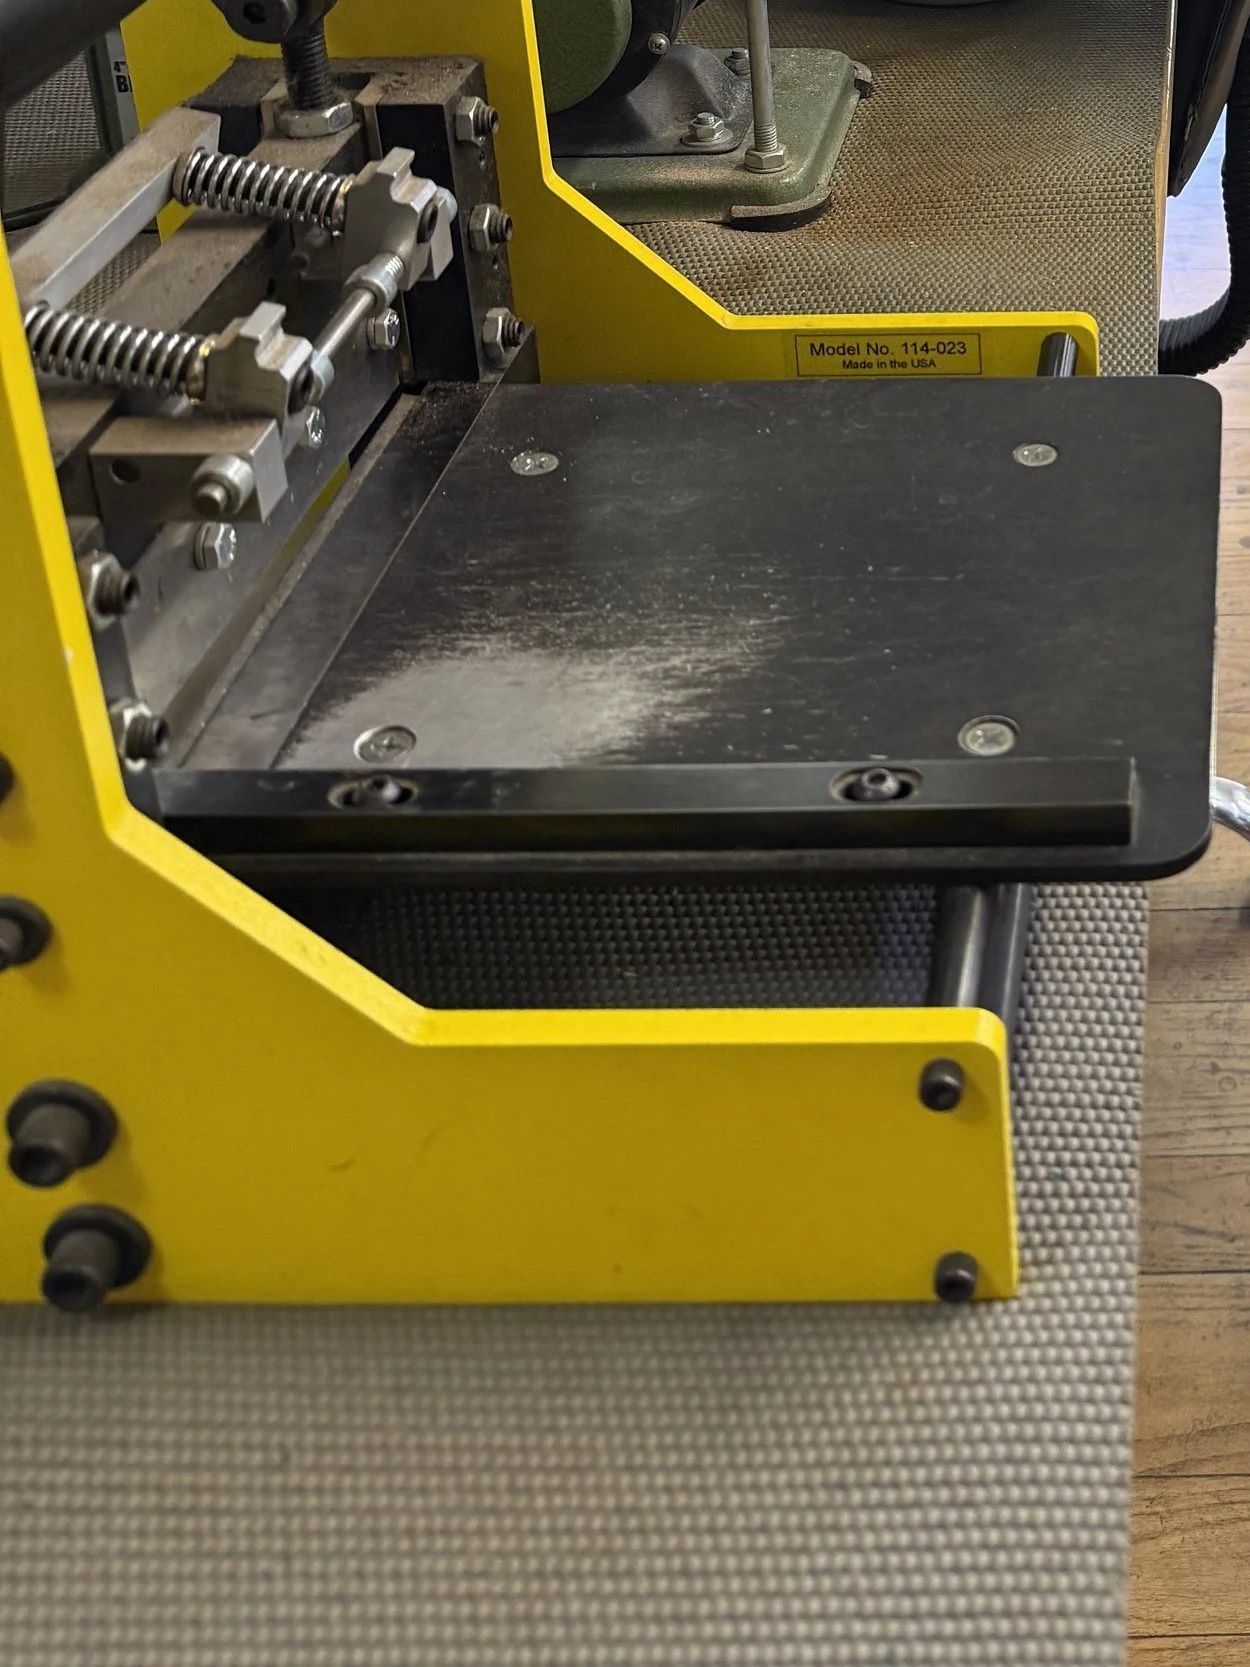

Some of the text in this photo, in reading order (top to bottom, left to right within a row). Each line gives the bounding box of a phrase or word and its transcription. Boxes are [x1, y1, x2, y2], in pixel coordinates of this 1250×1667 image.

[809, 341, 967, 357] Model No. 114-023
[842, 358, 936, 370] Made in the USA
